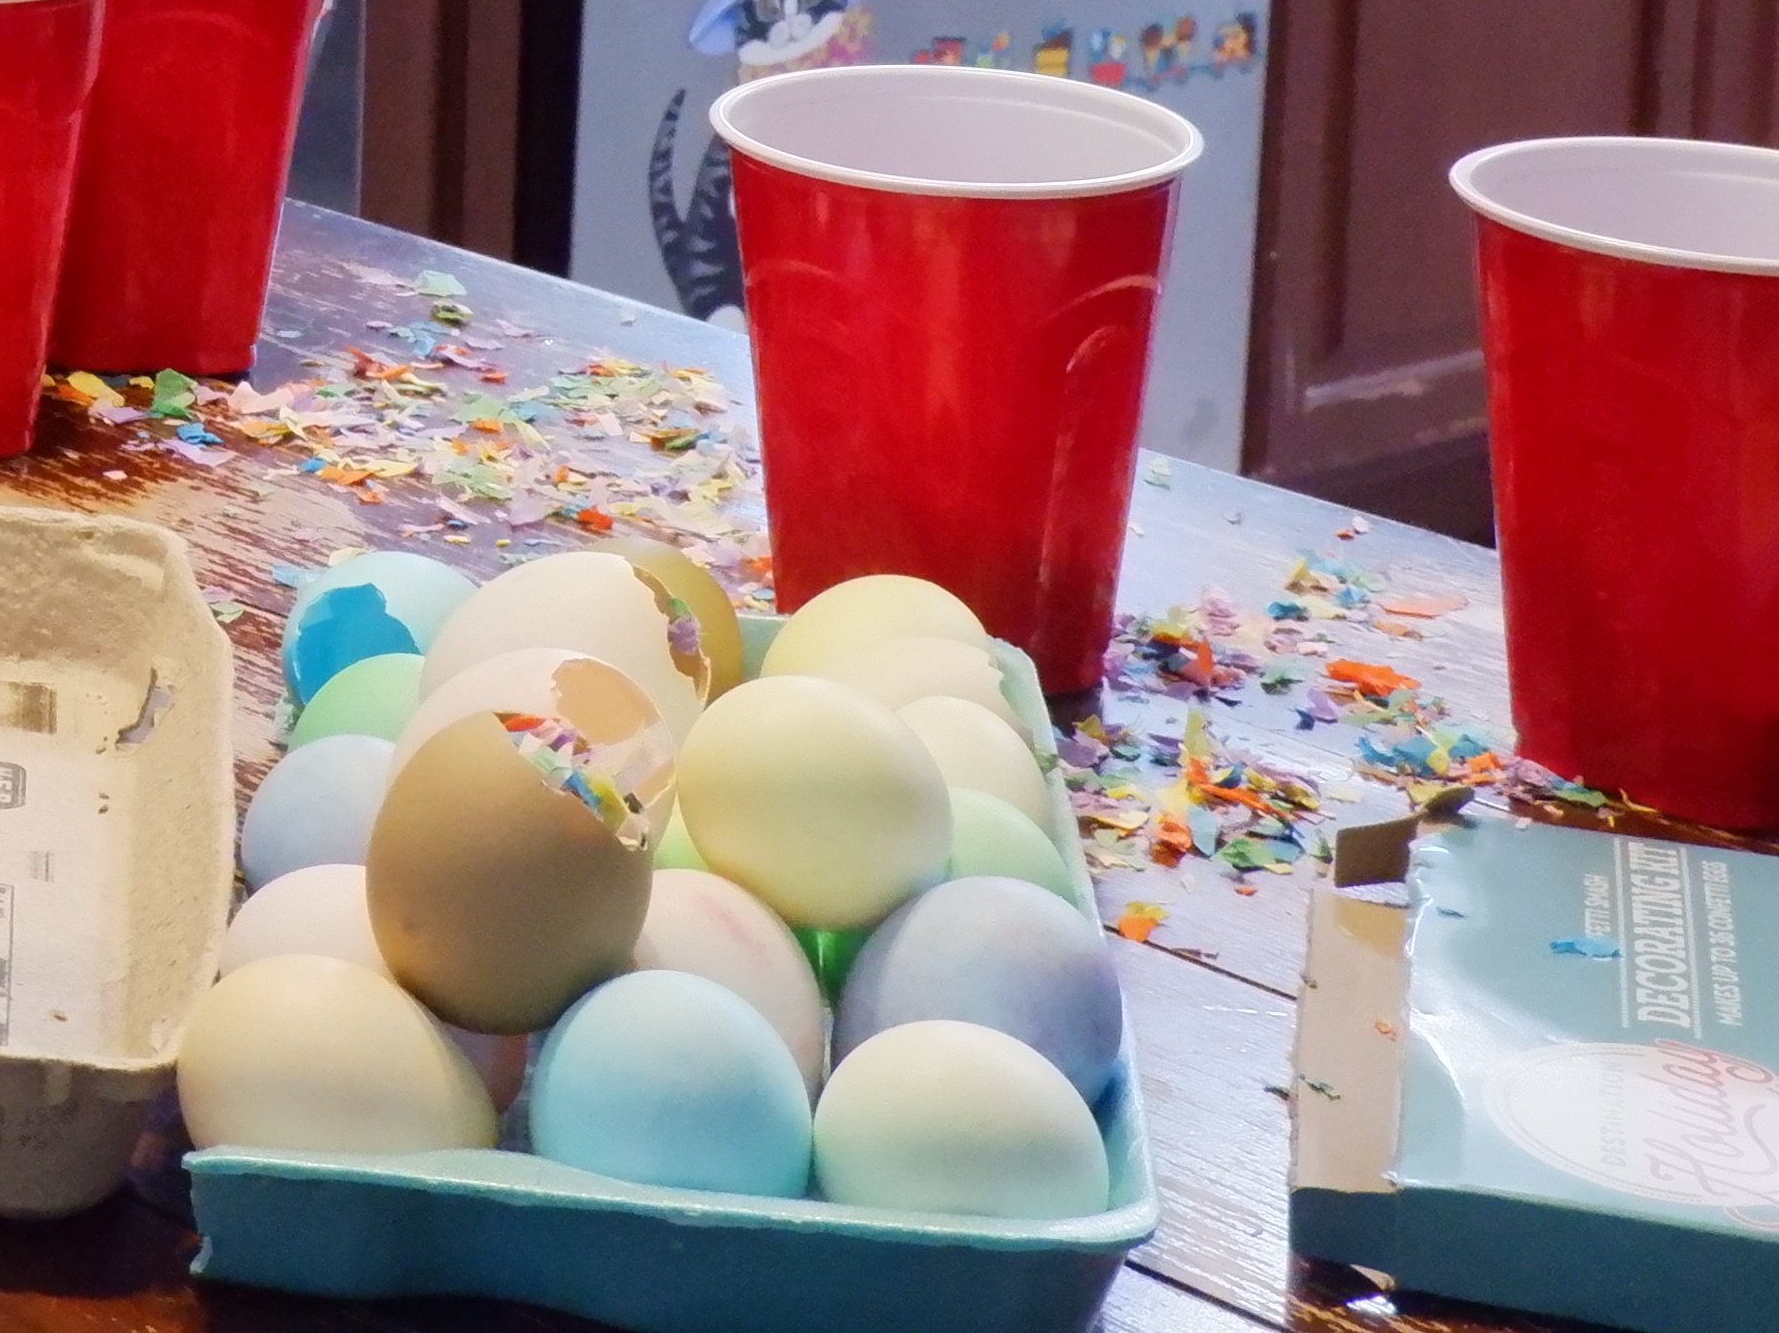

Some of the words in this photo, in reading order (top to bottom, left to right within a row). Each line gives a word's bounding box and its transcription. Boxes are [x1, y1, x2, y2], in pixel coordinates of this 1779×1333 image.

[1629, 841, 1681, 874] KIT
[1702, 860, 1729, 884] EGGS
[1584, 873, 1610, 901] SMASH
[1585, 902, 1611, 938] FETTI
[1705, 885, 1733, 928] CONFETTI
[1631, 875, 1691, 1028] DECORATING
[1709, 929, 1735, 946] 36
[1711, 946, 1737, 965] TO
[1713, 966, 1740, 985] UP
[1715, 986, 1742, 1026] MAKES
[1599, 1058, 1627, 1168] DESTINATION
[1646, 1038, 1773, 1218] Holiday
